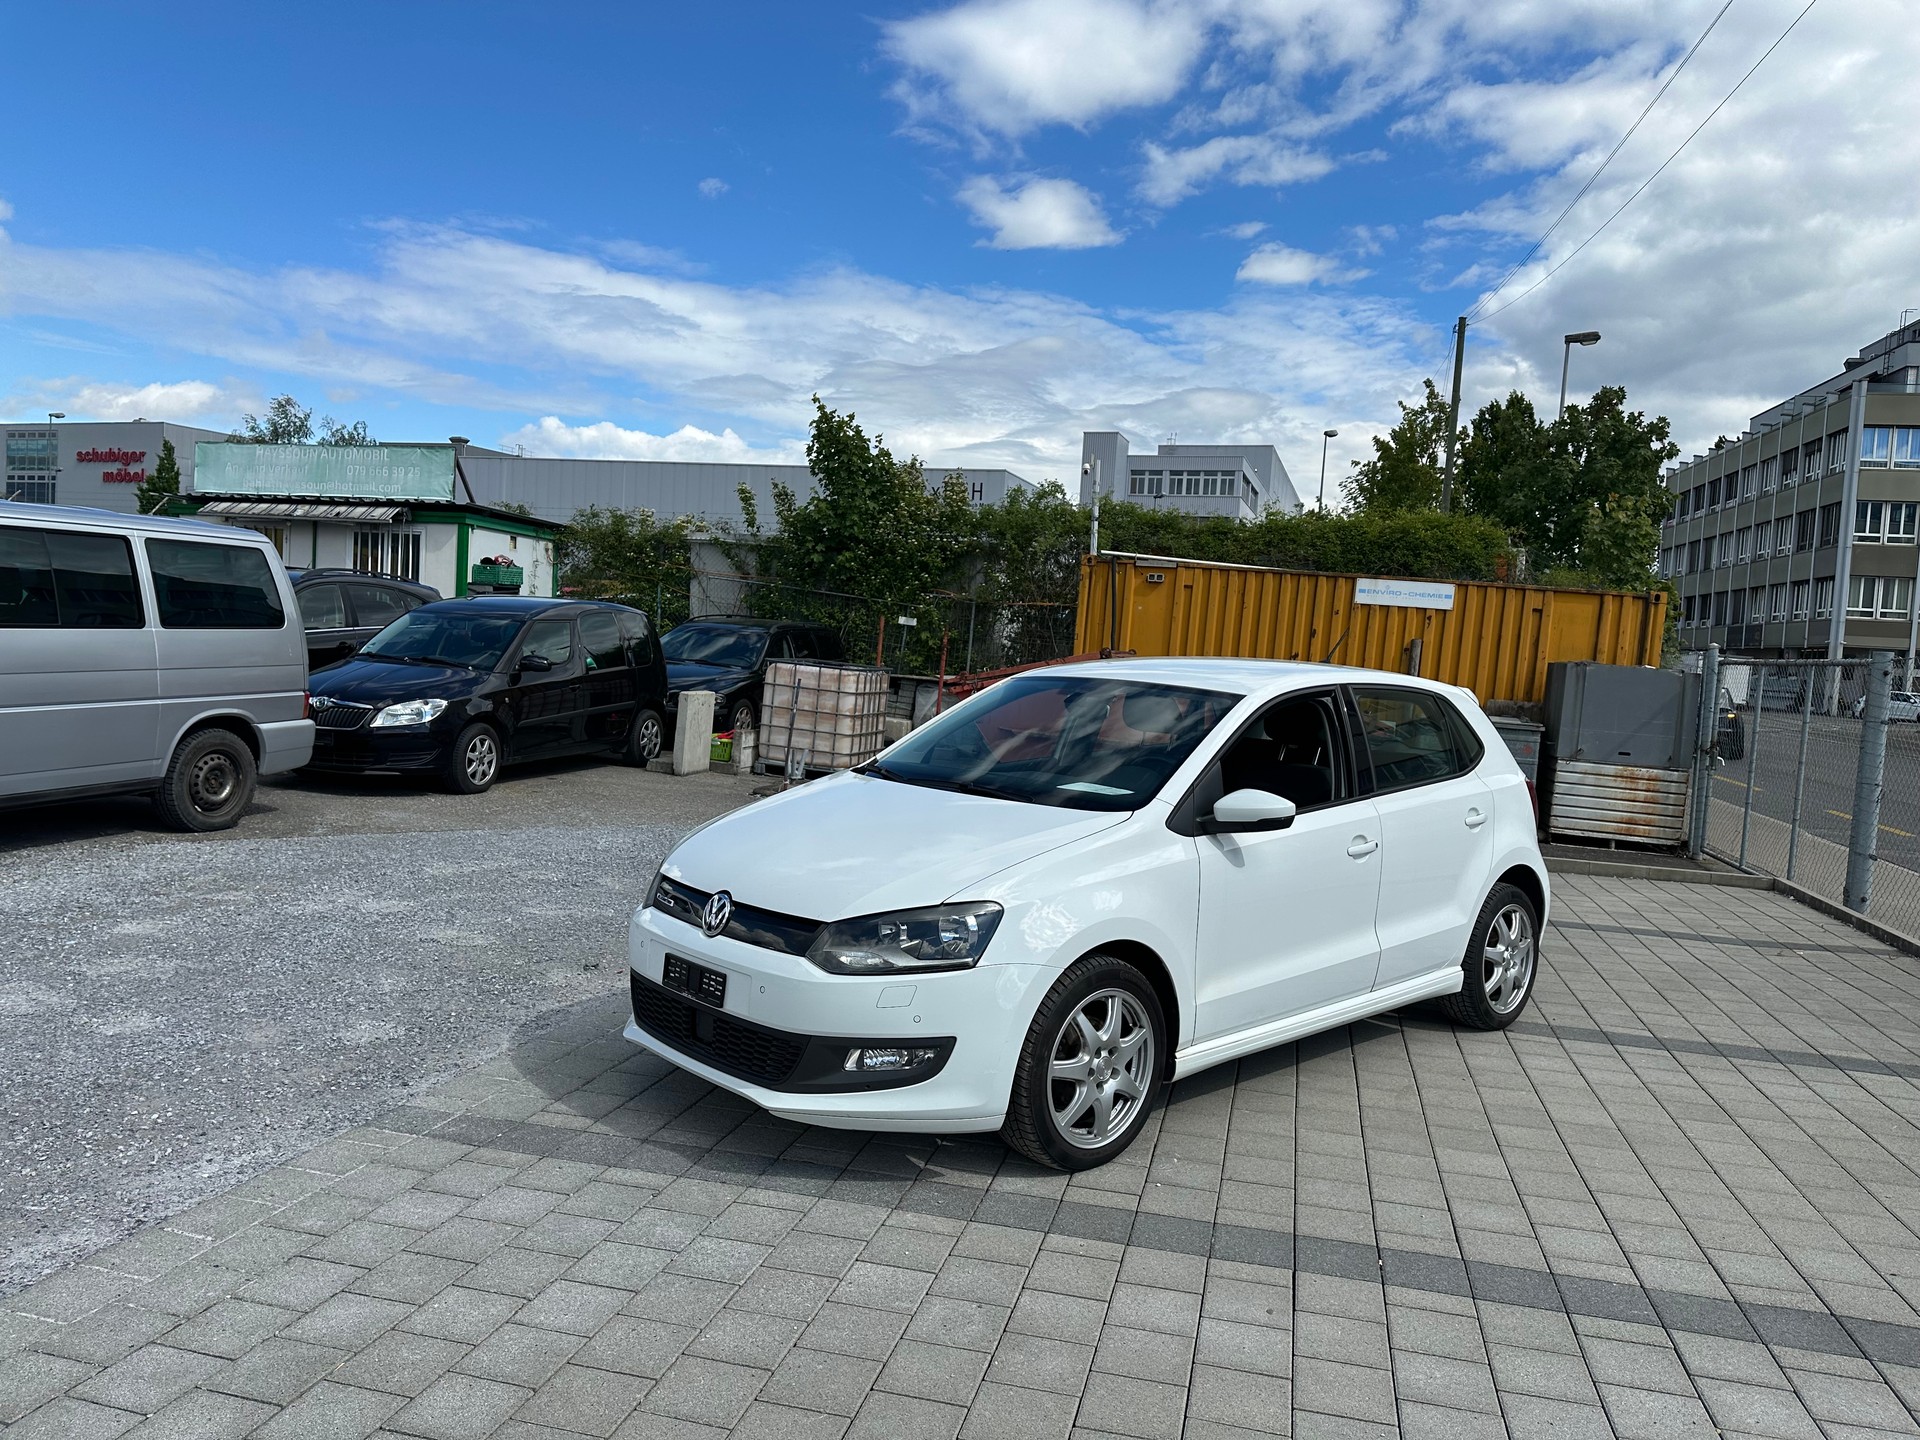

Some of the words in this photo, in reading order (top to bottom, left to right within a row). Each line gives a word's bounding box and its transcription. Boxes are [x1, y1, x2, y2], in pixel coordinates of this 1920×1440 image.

[77, 448, 146, 466] schubiger
[256, 447, 318, 460] HAYSSOUN
[320, 448, 390, 461] AUTOMOBIL
[102, 468, 145, 483] möbel
[346, 464, 366, 476] 079
[369, 465, 389, 477] 666
[391, 466, 405, 477] 39
[407, 466, 421, 477] 25
